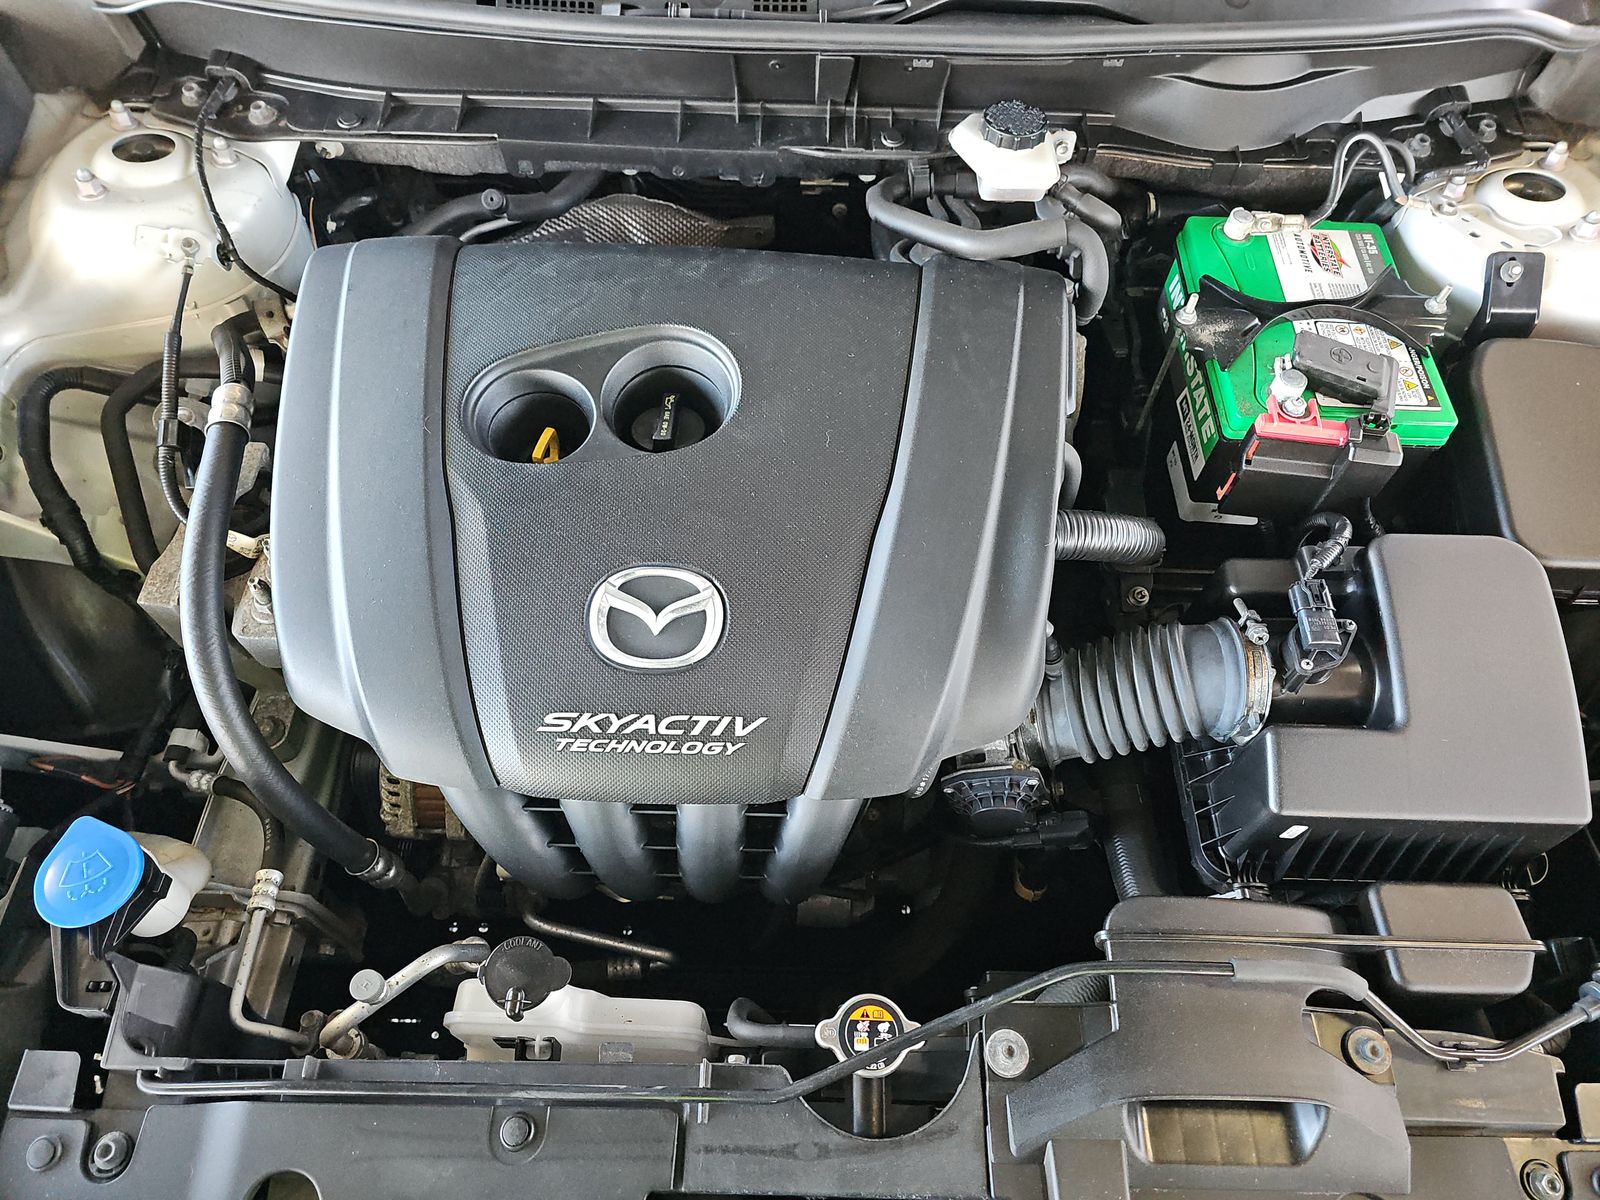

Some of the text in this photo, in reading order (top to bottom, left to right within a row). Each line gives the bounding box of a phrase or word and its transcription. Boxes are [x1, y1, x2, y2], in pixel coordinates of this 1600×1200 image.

[1294, 233, 1313, 273] AUTOMOTIVE
[1312, 234, 1331, 273] BATTERIES
[1320, 232, 1341, 276] INTERSTATE
[536, 712, 768, 737] SKYACTIV
[555, 737, 748, 756] TECHNOLOGY
[503, 937, 544, 951] COOLANT
